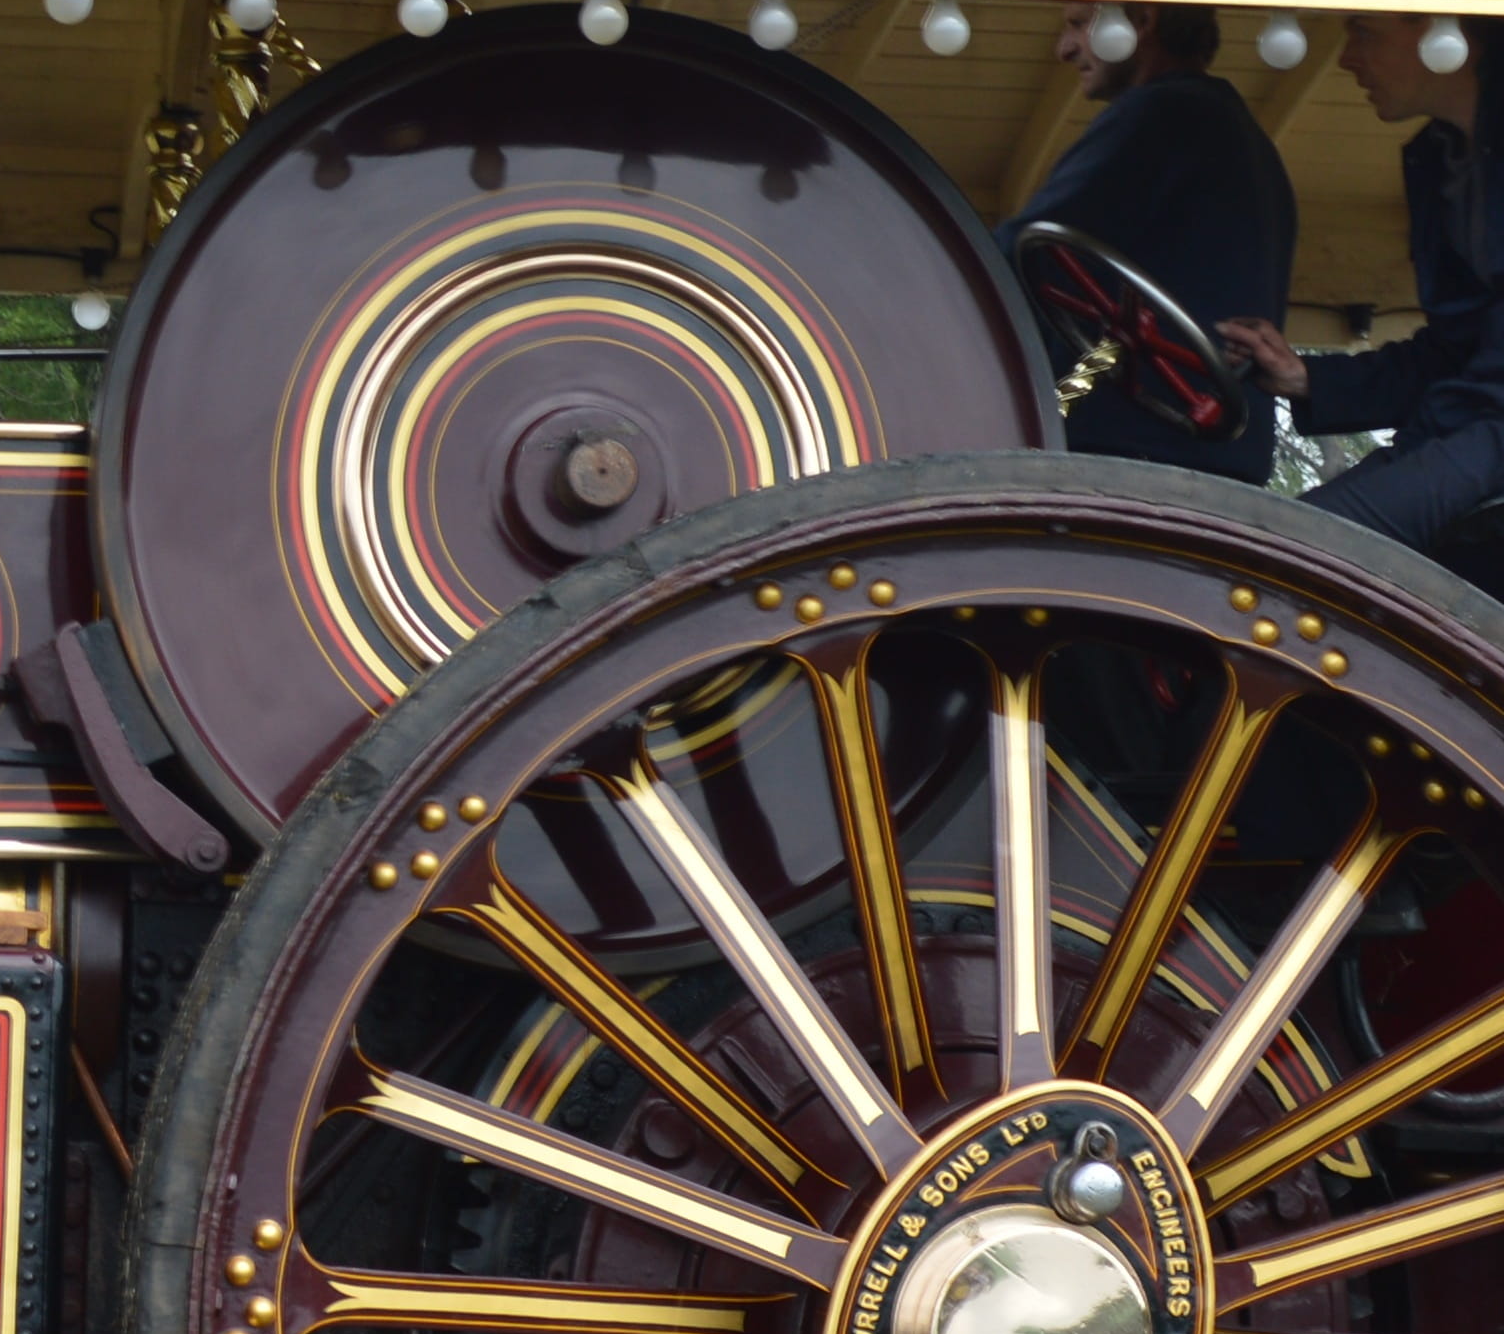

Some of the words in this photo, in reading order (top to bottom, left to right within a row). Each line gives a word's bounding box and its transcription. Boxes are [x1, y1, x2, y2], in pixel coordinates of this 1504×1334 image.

[897, 1212, 928, 1238] &
[918, 1141, 990, 1209] SONS
[1130, 1150, 1192, 1318] ENGINEERS
